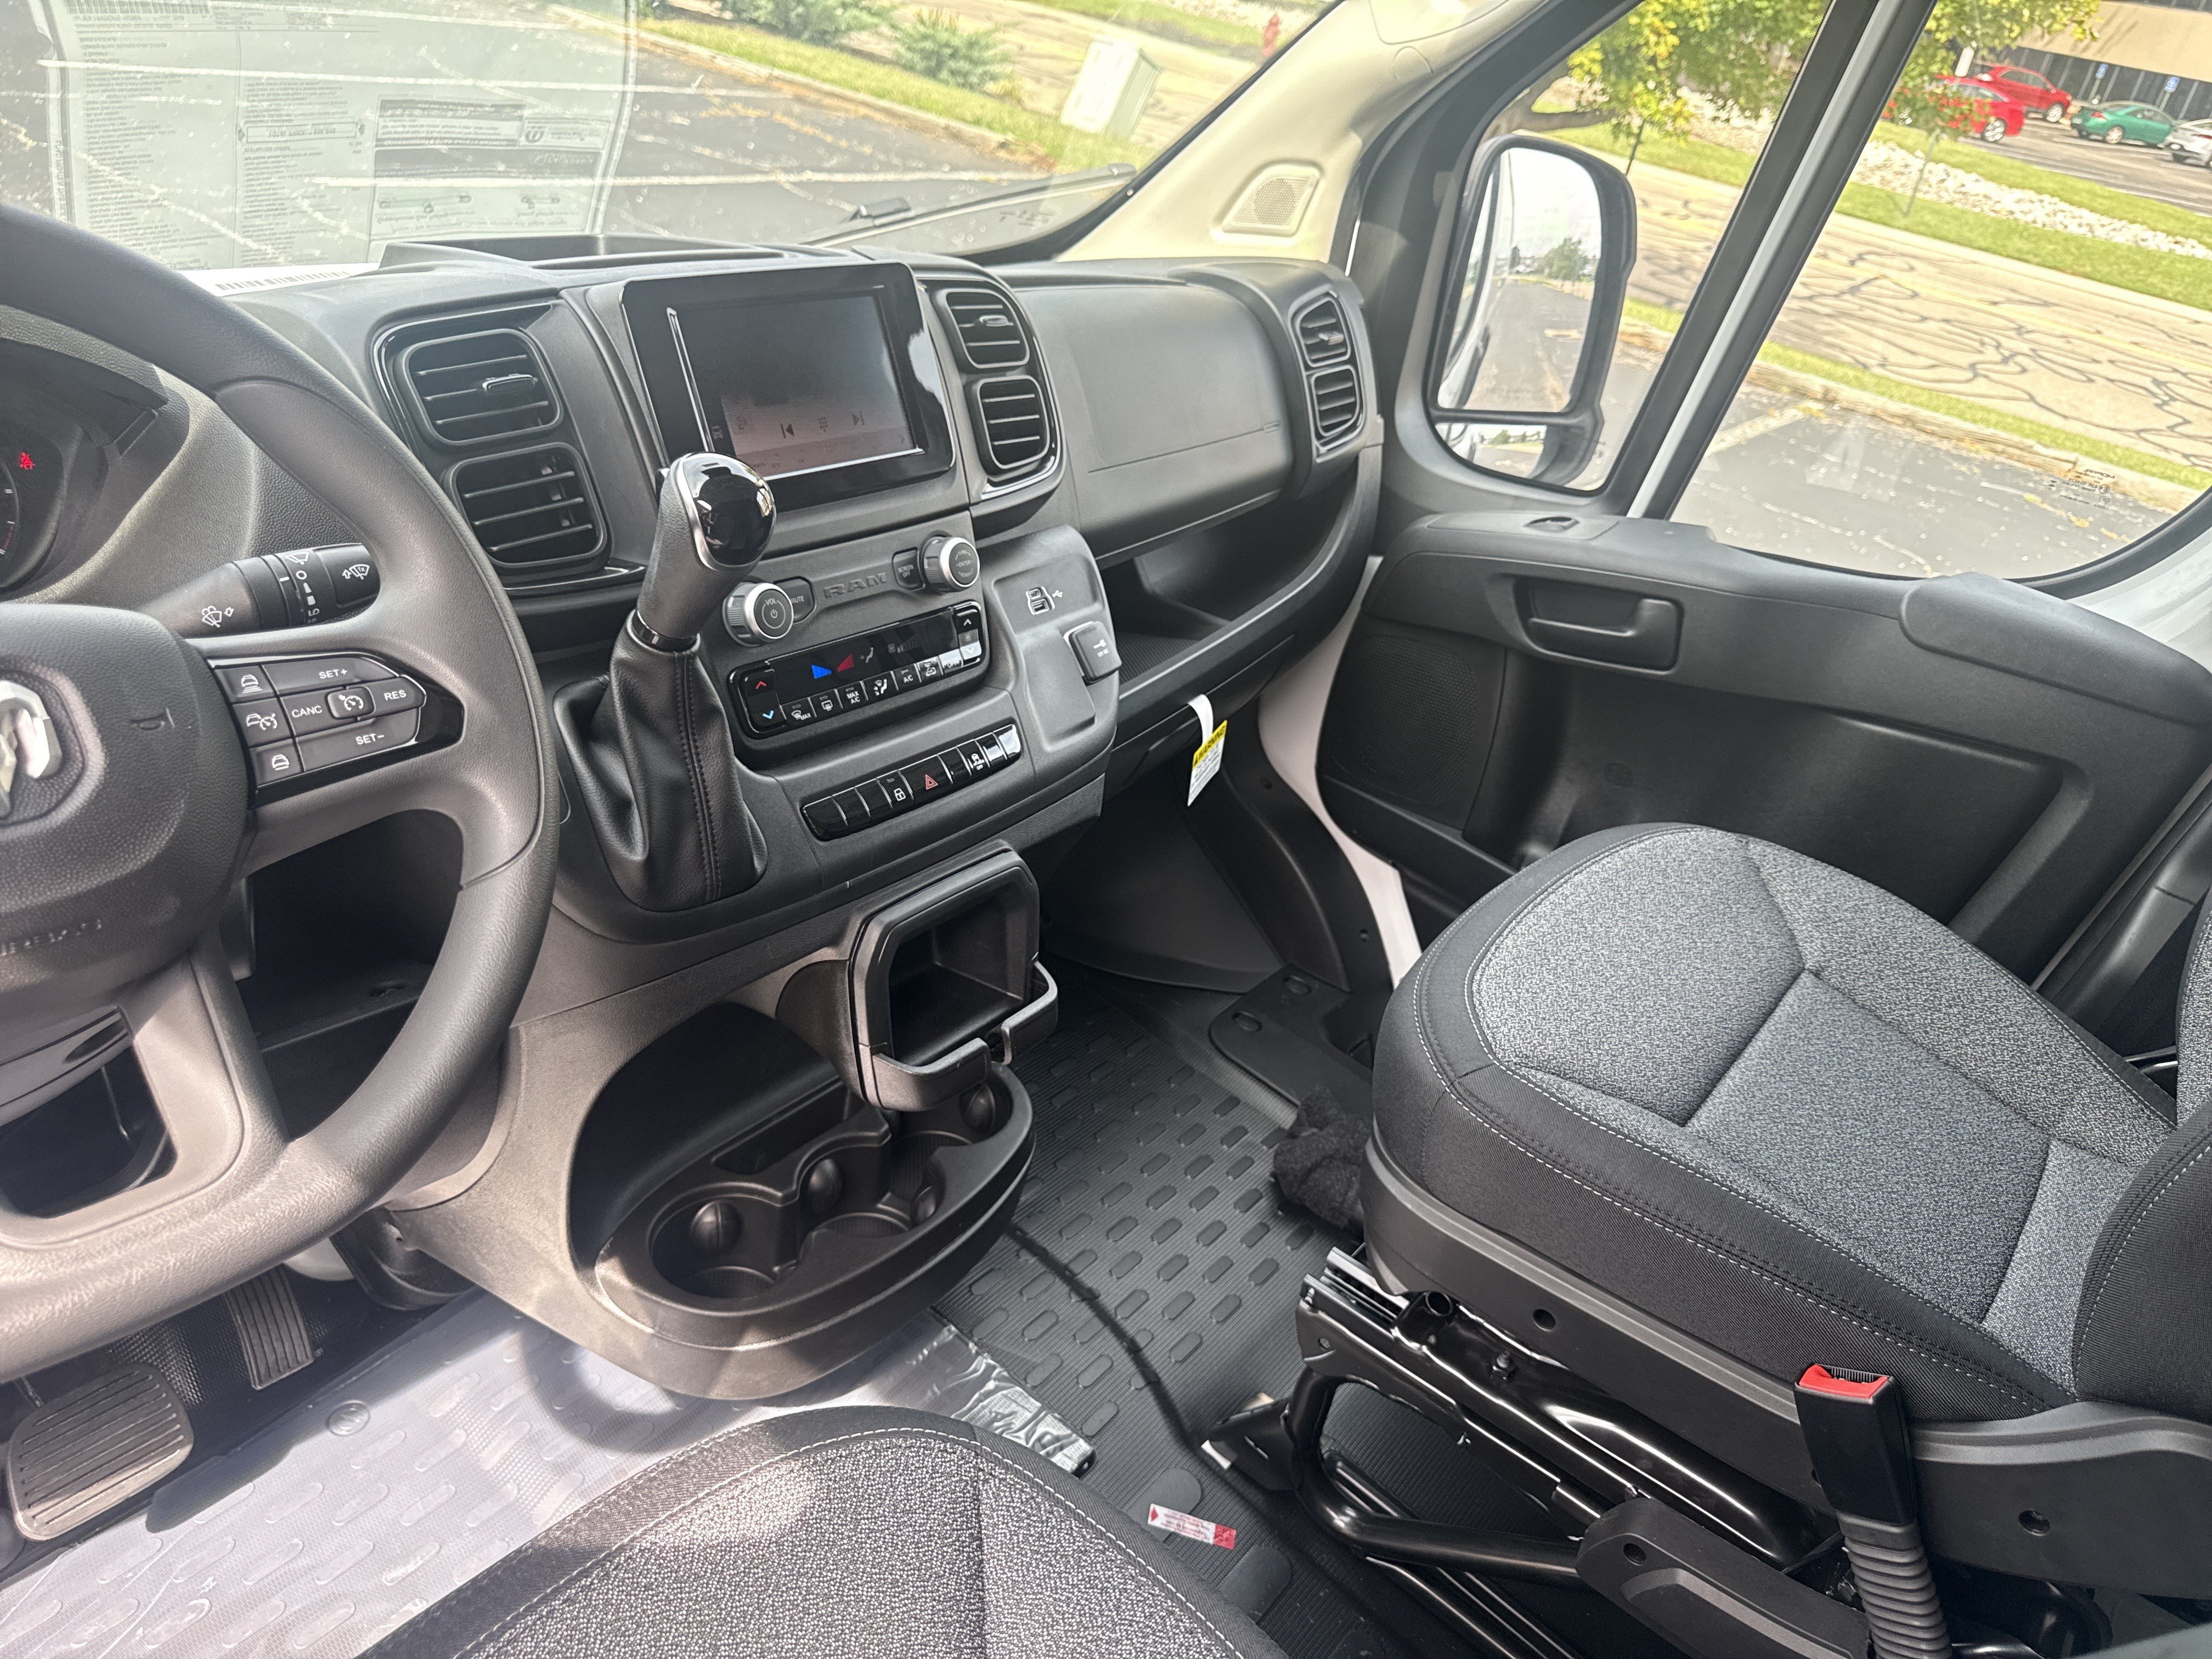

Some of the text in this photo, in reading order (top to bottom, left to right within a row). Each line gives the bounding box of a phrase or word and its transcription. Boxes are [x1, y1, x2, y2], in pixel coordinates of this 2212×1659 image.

[898, 565, 914, 573] SCREEN
[824, 572, 887, 598] RAM
[308, 608, 320, 616] LO
[383, 690, 407, 701] RES
[847, 690, 860, 699] MAX
[291, 704, 323, 718] CANC
